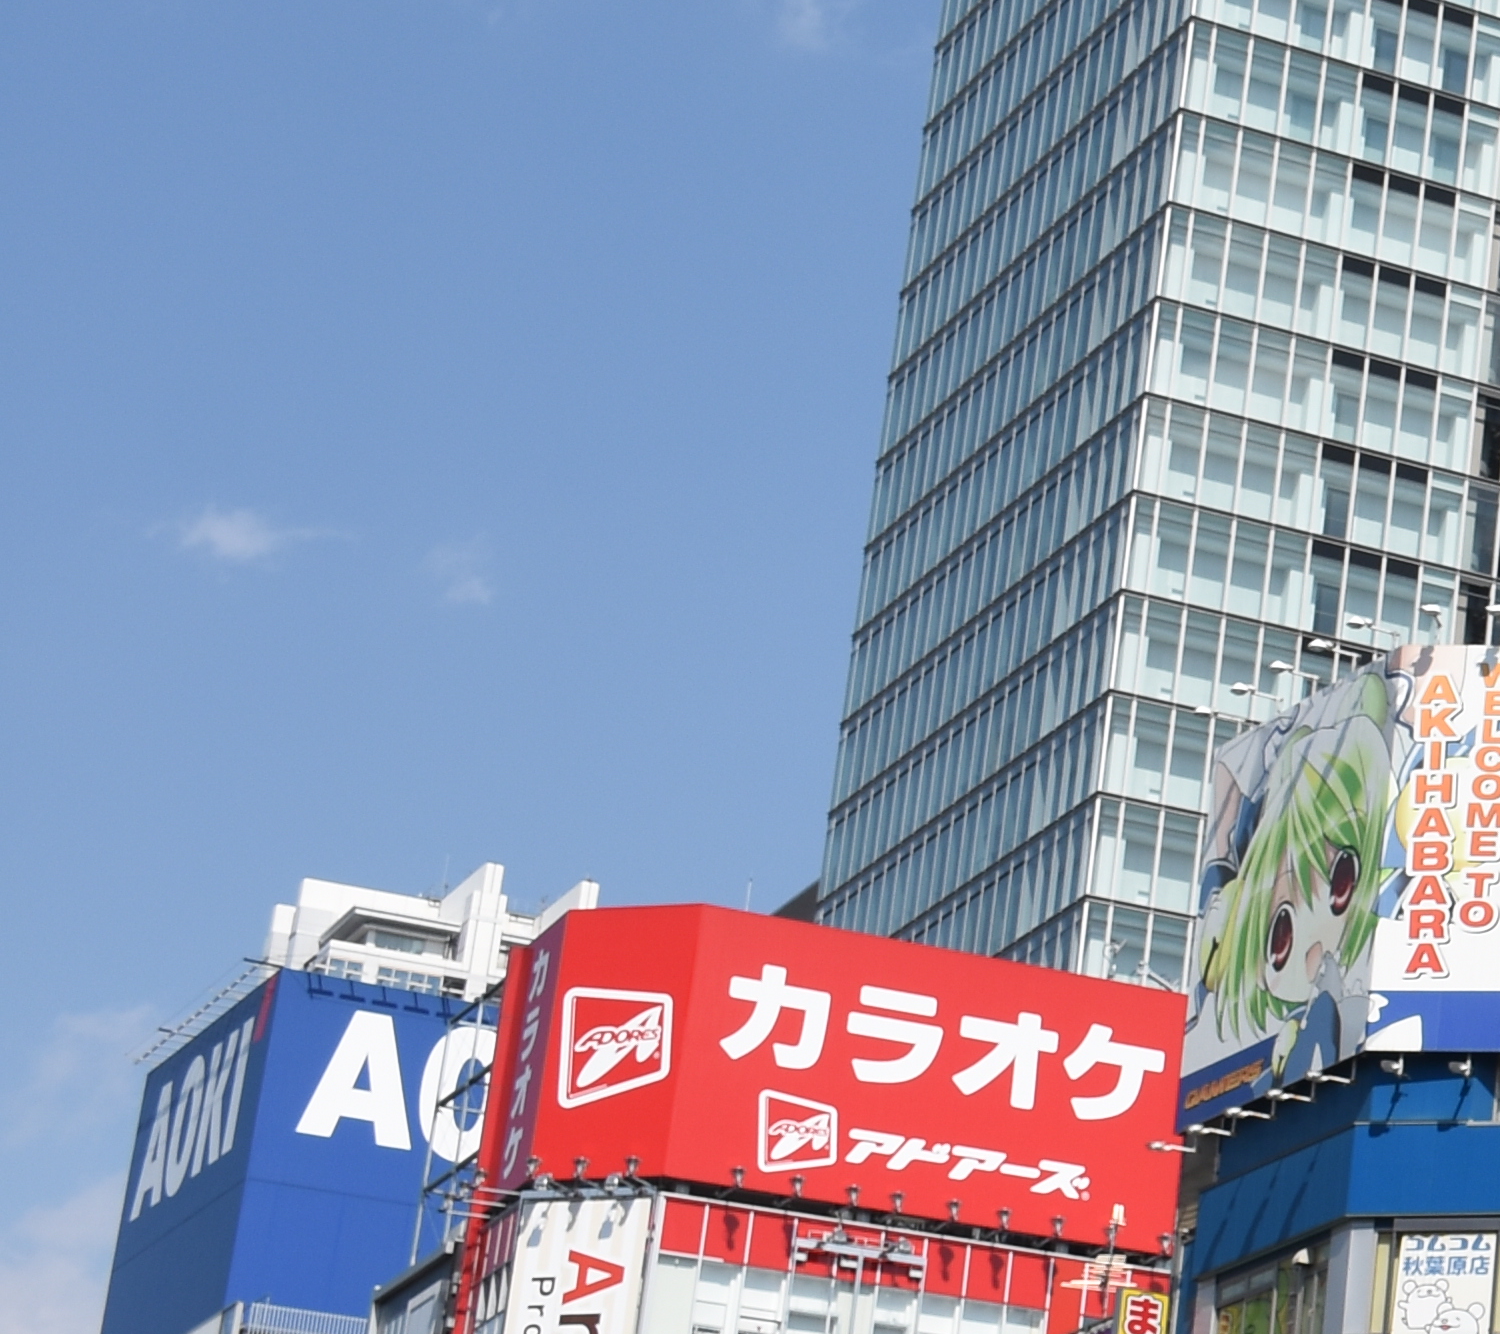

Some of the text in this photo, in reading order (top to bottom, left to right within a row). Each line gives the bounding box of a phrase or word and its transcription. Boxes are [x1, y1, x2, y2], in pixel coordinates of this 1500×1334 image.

[1402, 673, 1460, 982] AKIHABARA
[1458, 870, 1496, 934] TO
[129, 1014, 256, 1223] AOKI
[295, 1009, 498, 1164] AO
[503, 948, 551, 1180] カラオケ
[719, 963, 1167, 1121] カラオケ
[845, 1127, 1087, 1200] アドアーズ
[1403, 1256, 1490, 1277] 秋葉原店
